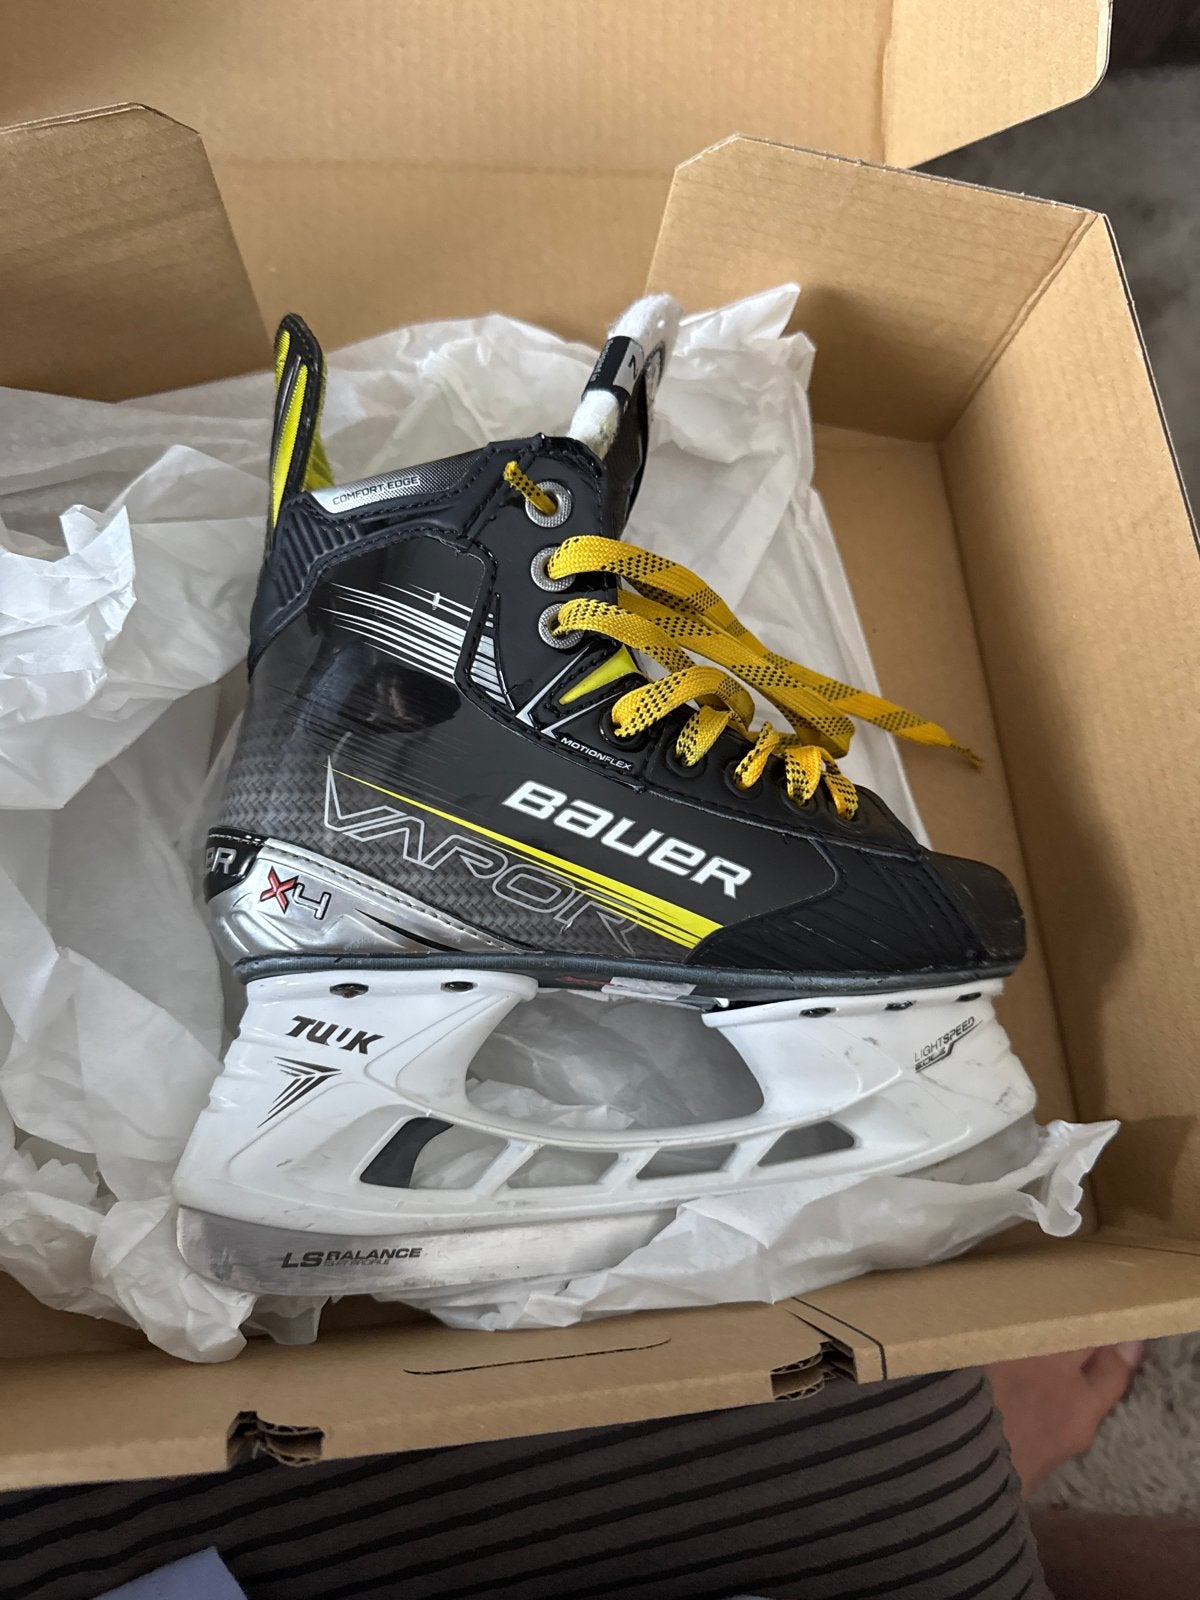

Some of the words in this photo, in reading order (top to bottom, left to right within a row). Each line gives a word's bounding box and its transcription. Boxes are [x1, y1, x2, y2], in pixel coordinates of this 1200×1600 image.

[332, 483, 385, 505] COMFORT
[387, 475, 419, 490] EDGE
[560, 736, 632, 770] MOTIONFLEX
[324, 755, 640, 954] VAPOR
[501, 780, 752, 899] BAUER
[259, 866, 332, 920] X4
[914, 1016, 975, 1062] LIGHTSPEED
[281, 1251, 325, 1268] LS
